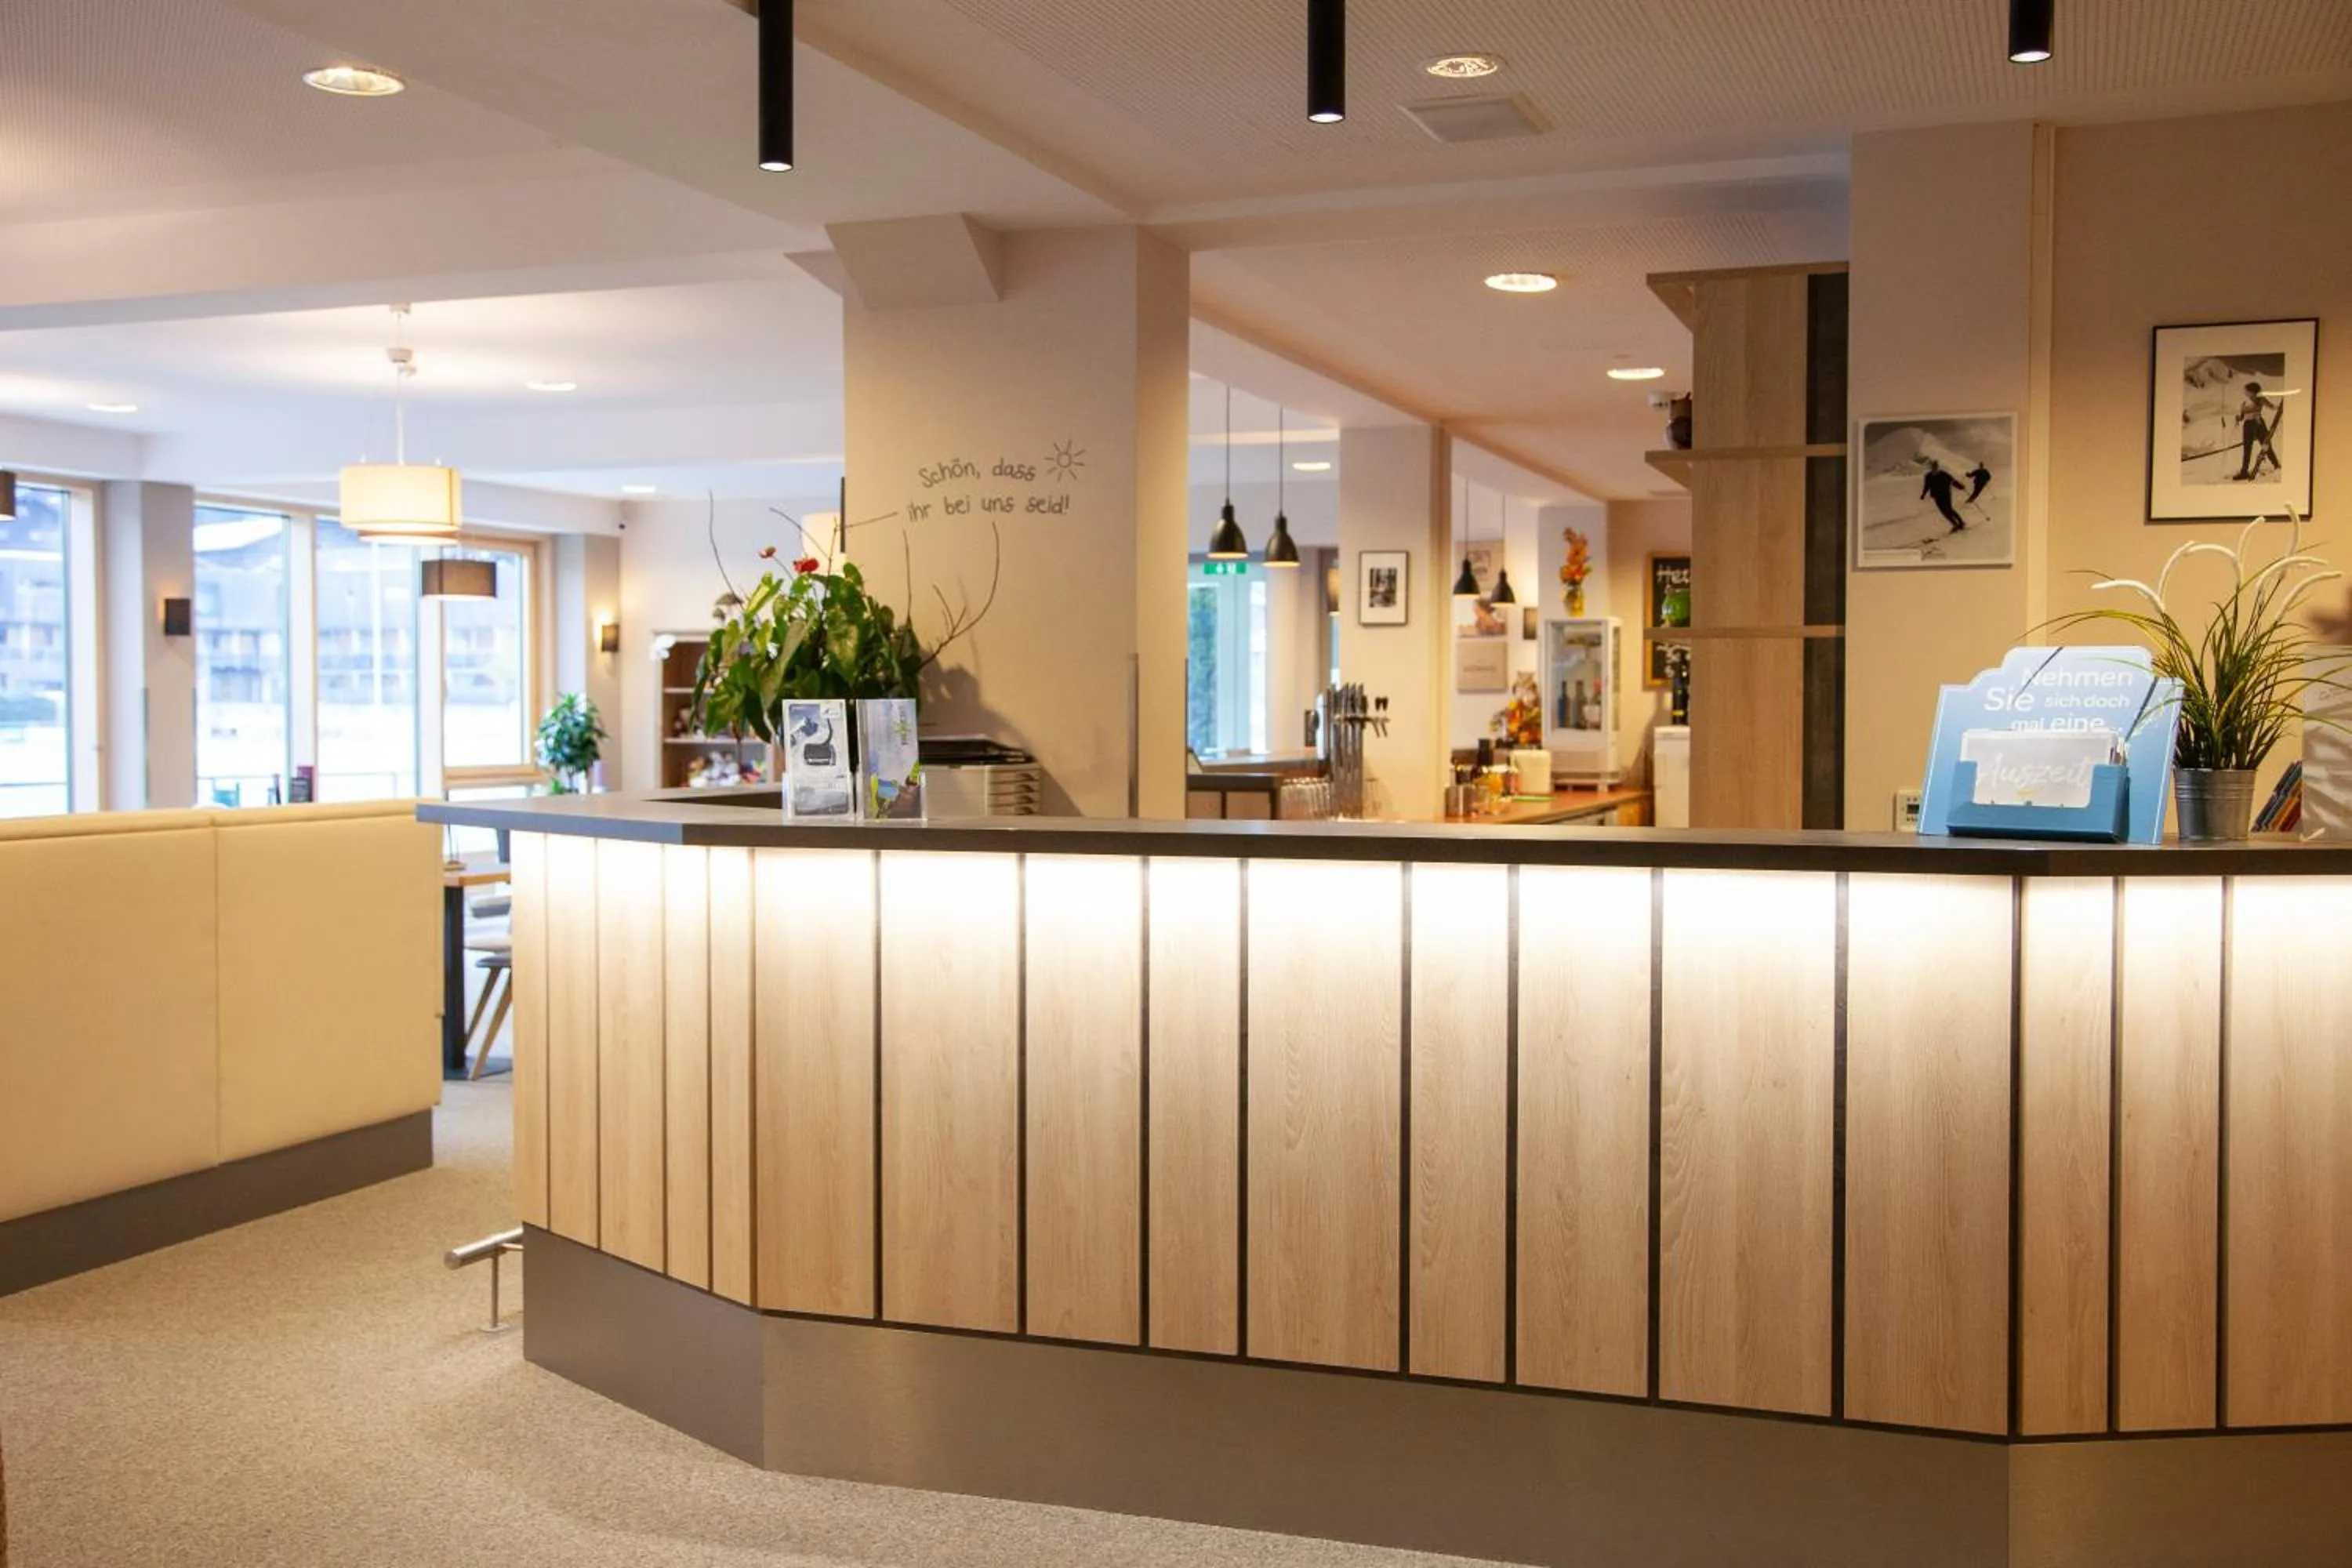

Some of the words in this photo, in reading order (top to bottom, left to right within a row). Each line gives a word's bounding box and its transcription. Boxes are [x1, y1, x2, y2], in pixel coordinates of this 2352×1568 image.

[918, 458, 981, 488] Schön,
[992, 458, 1036, 481] dass
[906, 502, 932, 522] ihr
[944, 495, 970, 515] bei
[982, 495, 1014, 514] uns
[1025, 495, 1069, 515] seid!
[2020, 667, 2133, 687] Nehmen
[1984, 686, 2034, 712] Sie
[2044, 694, 2080, 707] sich
[2083, 694, 2130, 708] doch
[2050, 713, 2105, 732] eine
